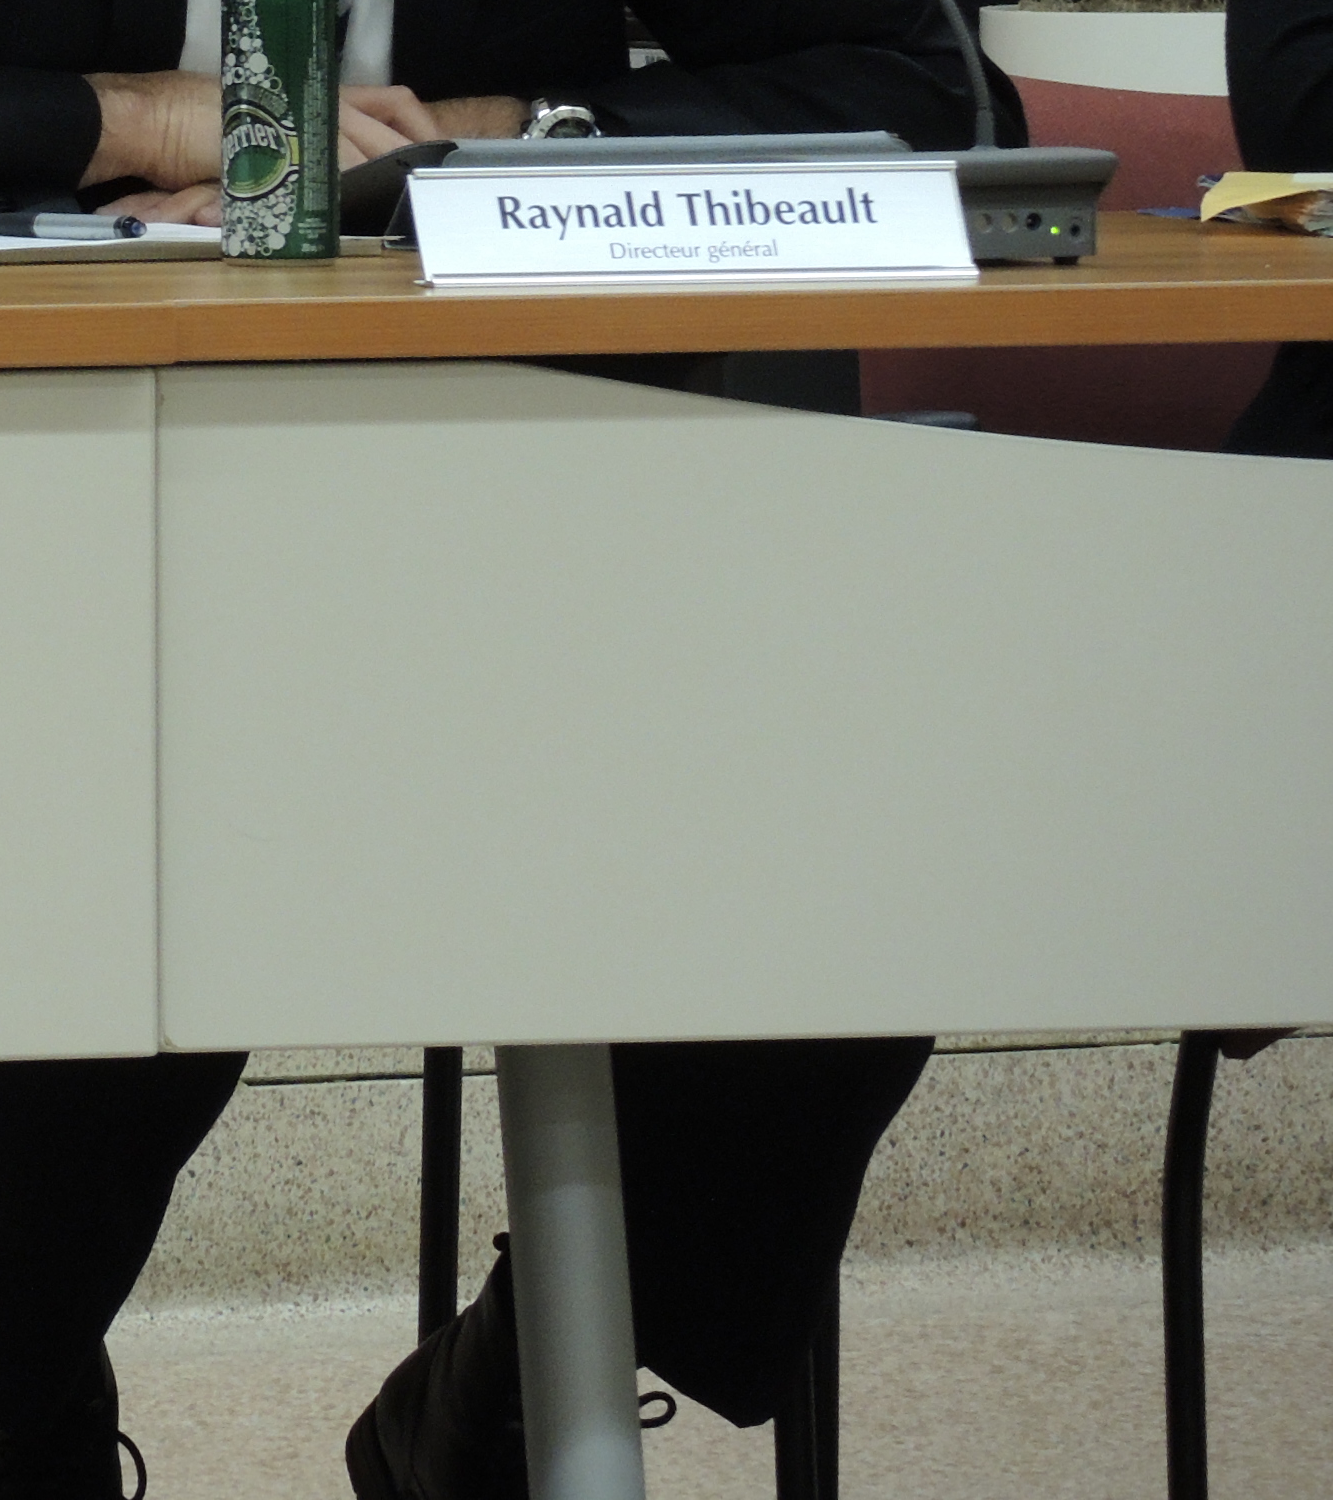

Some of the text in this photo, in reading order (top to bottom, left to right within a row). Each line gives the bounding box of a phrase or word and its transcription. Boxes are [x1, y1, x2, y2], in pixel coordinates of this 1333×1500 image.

[497, 187, 878, 240] Raynald Thibeault
[608, 240, 778, 264] Directeur général
